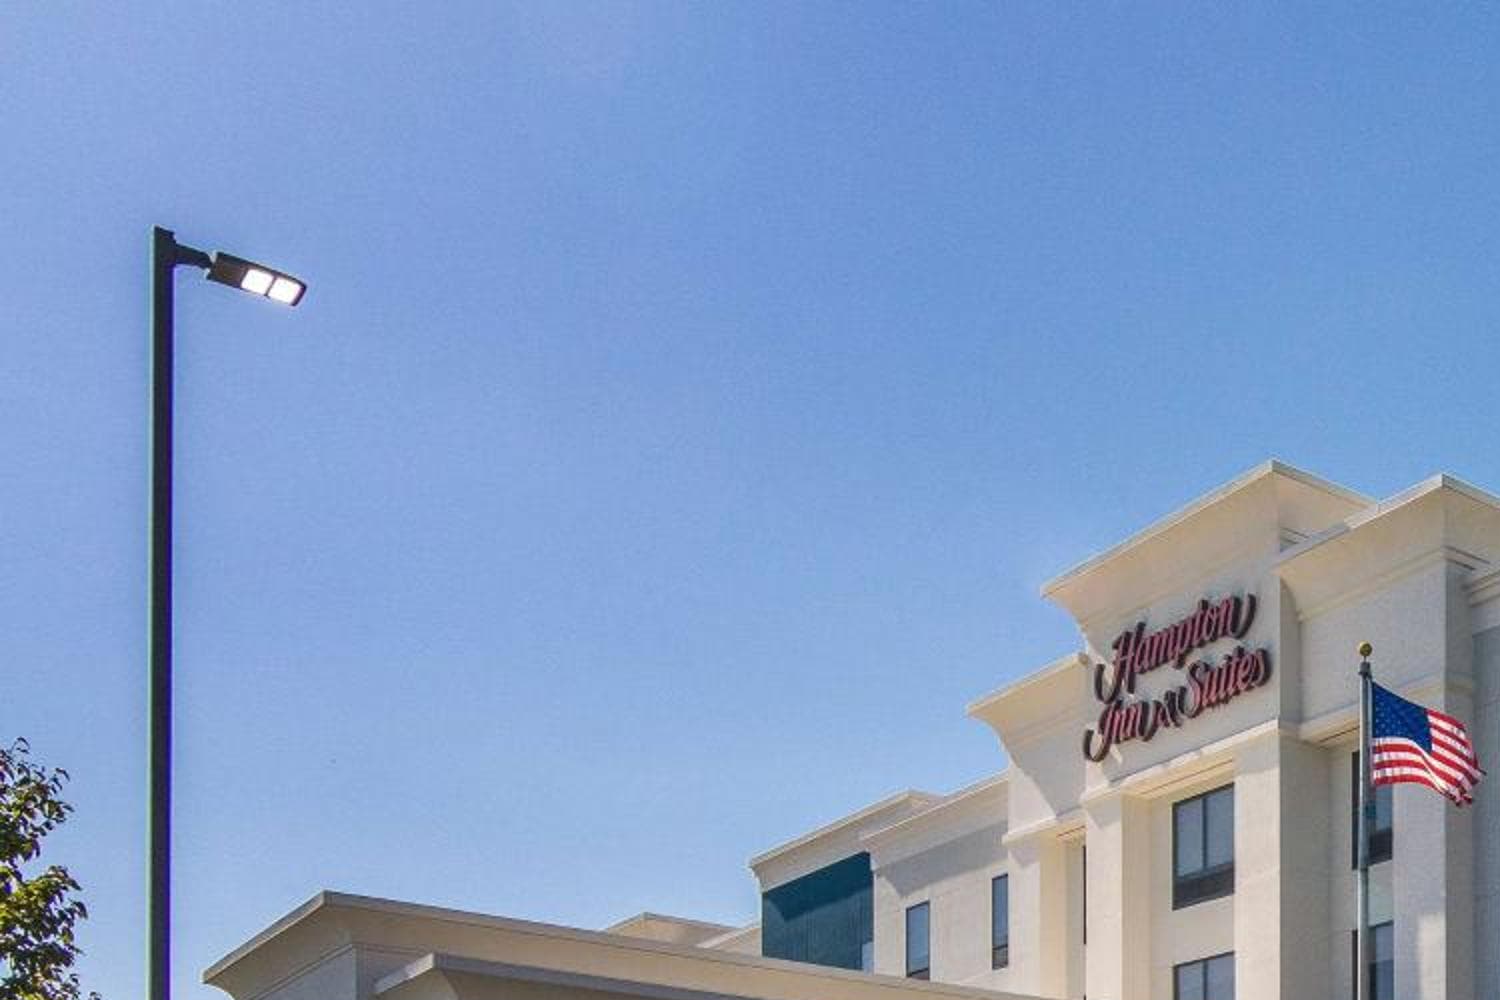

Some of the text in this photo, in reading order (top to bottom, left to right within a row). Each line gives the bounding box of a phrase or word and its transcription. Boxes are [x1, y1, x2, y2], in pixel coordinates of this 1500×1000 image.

[1083, 700, 1157, 763] Inn
[1177, 647, 1271, 718] Suites
[1095, 593, 1257, 705] Hampton
